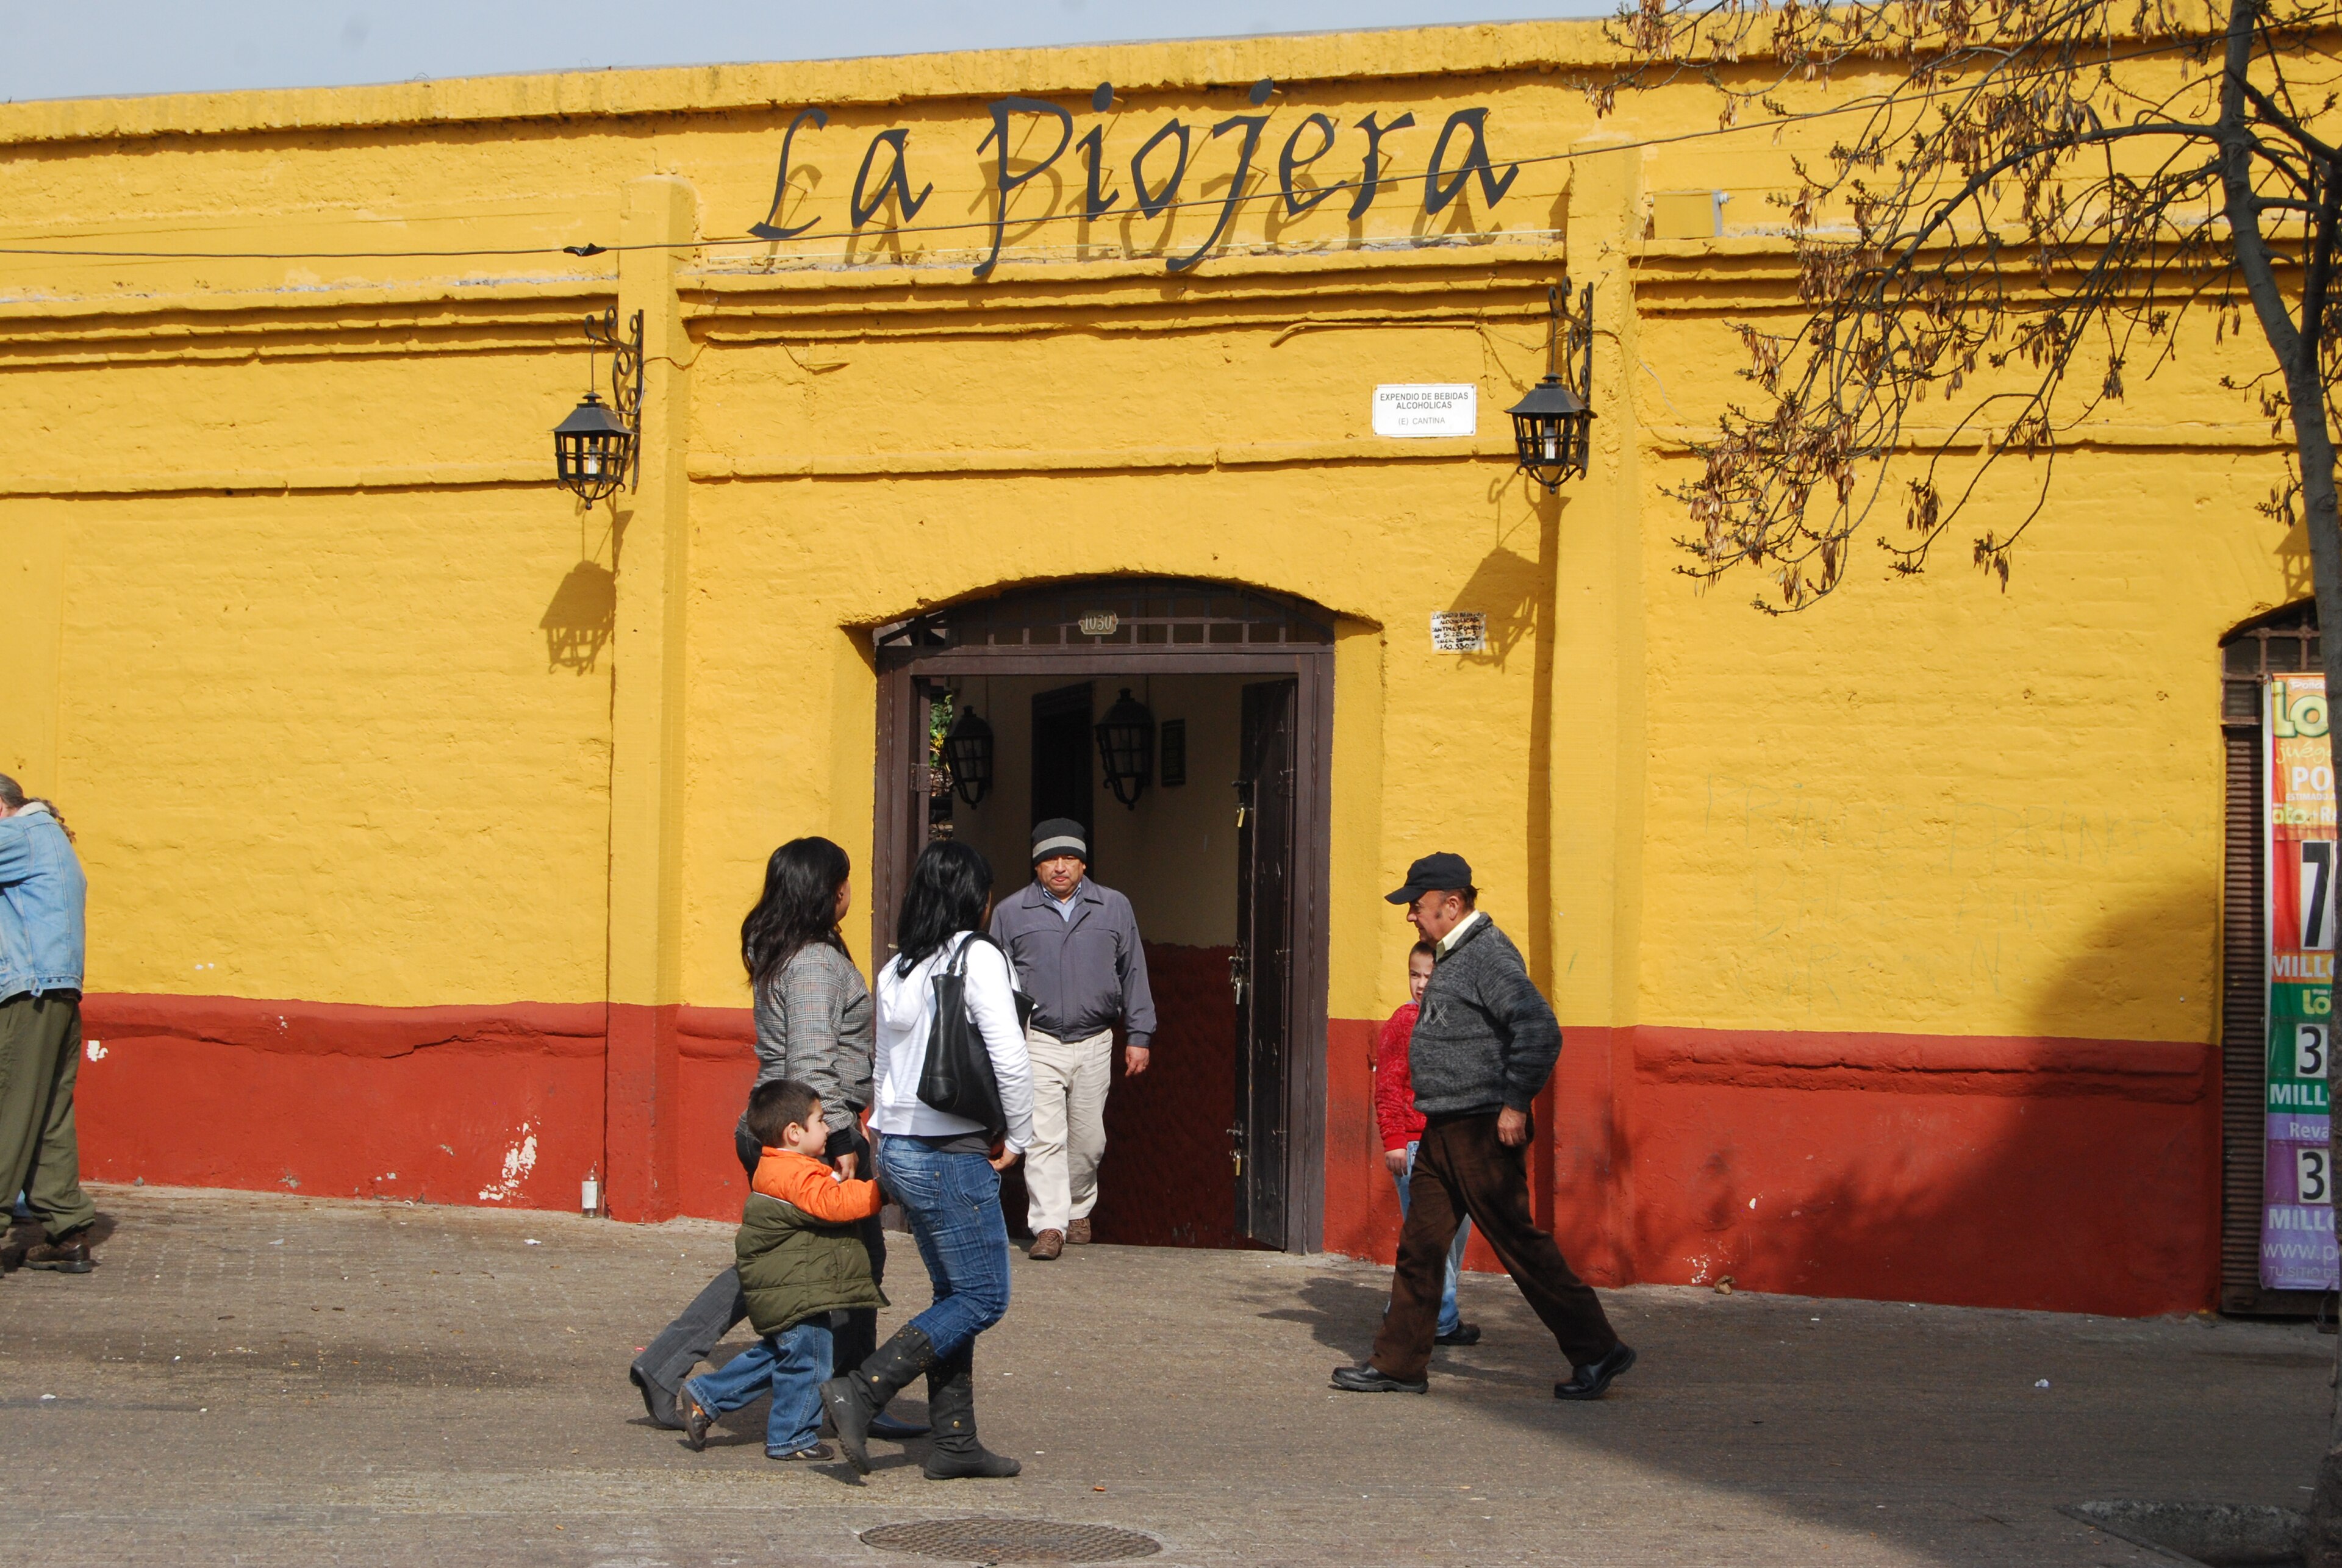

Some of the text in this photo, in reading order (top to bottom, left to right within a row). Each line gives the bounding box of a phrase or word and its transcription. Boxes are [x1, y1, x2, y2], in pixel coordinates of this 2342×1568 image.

[746, 77, 1520, 277] La Piojera
[1085, 615, 1112, 631] 1030
[2302, 842, 2330, 948] 7
[2299, 1026, 2322, 1075] 3
[2269, 1083, 2330, 1106] MILL
[2290, 1122, 2330, 1139] Reva
[2302, 1151, 2325, 1200] 3
[2263, 1243, 2340, 1266] www.p
[2268, 1265, 2284, 1276] TU
[2288, 1267, 2320, 1278] SITIO
